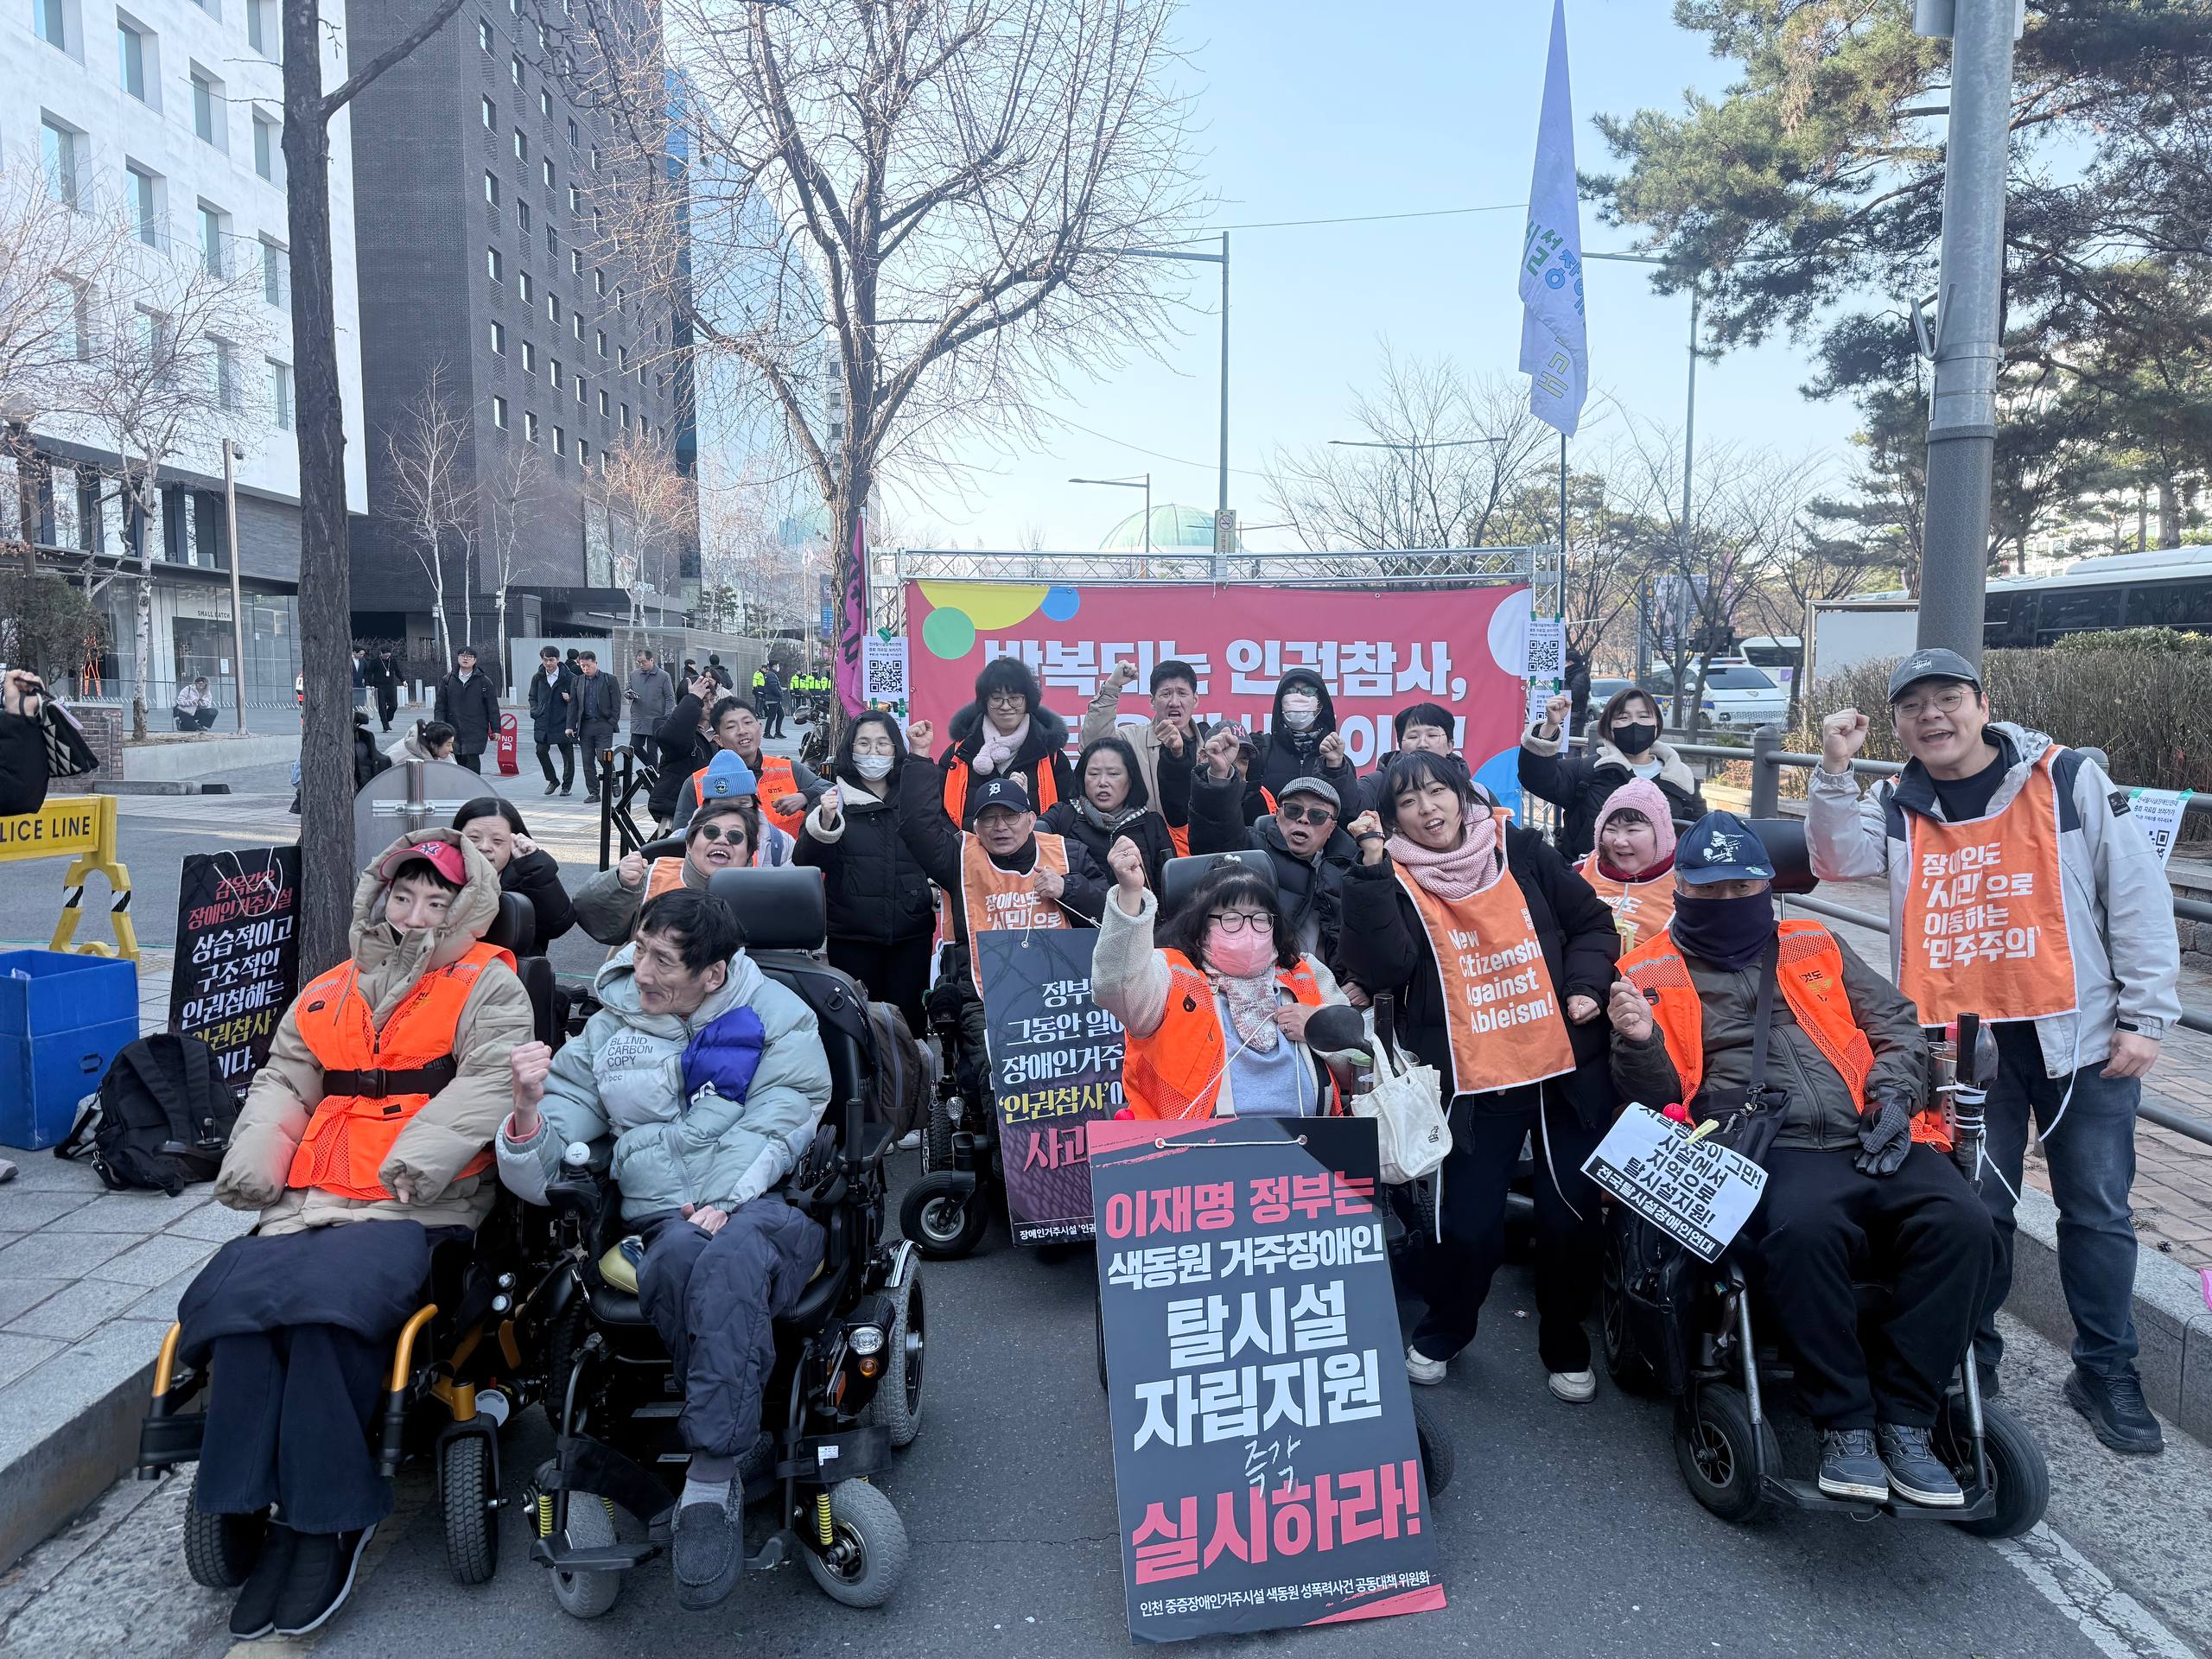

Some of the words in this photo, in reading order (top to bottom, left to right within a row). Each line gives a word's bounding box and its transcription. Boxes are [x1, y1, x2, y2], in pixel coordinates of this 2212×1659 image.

[1225, 639, 1467, 702] 인권참사,
[52, 816, 91, 838] LINE
[1922, 841, 2001, 877] 장애인도
[188, 887, 293, 931] 장애인거주시설
[985, 891, 1042, 912] 장애인도
[1921, 872, 2034, 909] '시민'으로
[192, 915, 293, 964] 상습적이고
[1447, 928, 1478, 950] New
[1923, 905, 2009, 936] 이동하는
[1922, 925, 2042, 969] '민주주의'
[197, 948, 281, 994] 구조적인
[1042, 978, 1093, 1007] 정부
[1466, 967, 1539, 1007] Against
[181, 980, 285, 1031] 인권침해는
[1471, 991, 1554, 1034] Ableism!
[607, 1045, 653, 1057] CARBON
[610, 1035, 647, 1046] BLIND
[1007, 1012, 1083, 1046] 그동안
[607, 1055, 637, 1068] COPY
[1001, 1043, 1125, 1085] 장애인거주
[1645, 1148, 1718, 1205] 지역으로
[1657, 1134, 1729, 1189] 시설에서
[1724, 1154, 1763, 1191] 그만!
[1104, 1180, 1237, 1240] 이재명
[1249, 1170, 1375, 1229] 정부는
[1595, 1163, 1717, 1255] 전국탈시설장애인연대
[1622, 1156, 1717, 1229] 탈시설지원!
[1019, 1225, 1077, 1240] 장애인거주시설
[1077, 1223, 1096, 1235] '인권
[1108, 1242, 1211, 1291] 색동원
[1220, 1223, 1385, 1281] 거주장애인
[1166, 1280, 1348, 1370] 탈시설
[1134, 1349, 1382, 1452] 자립지원
[1244, 1434, 1301, 1499] 즉각
[1132, 1459, 1421, 1586] 실시하라!
[1140, 1599, 1164, 1618] 인천
[1165, 1587, 1264, 1615] 중증장애인거주시설
[1266, 1585, 1299, 1604] 색동원
[1300, 1579, 1354, 1600] 성폭력사건
[1355, 1574, 1397, 1593] 공동대책
[1398, 1569, 1430, 1588] 위원회
